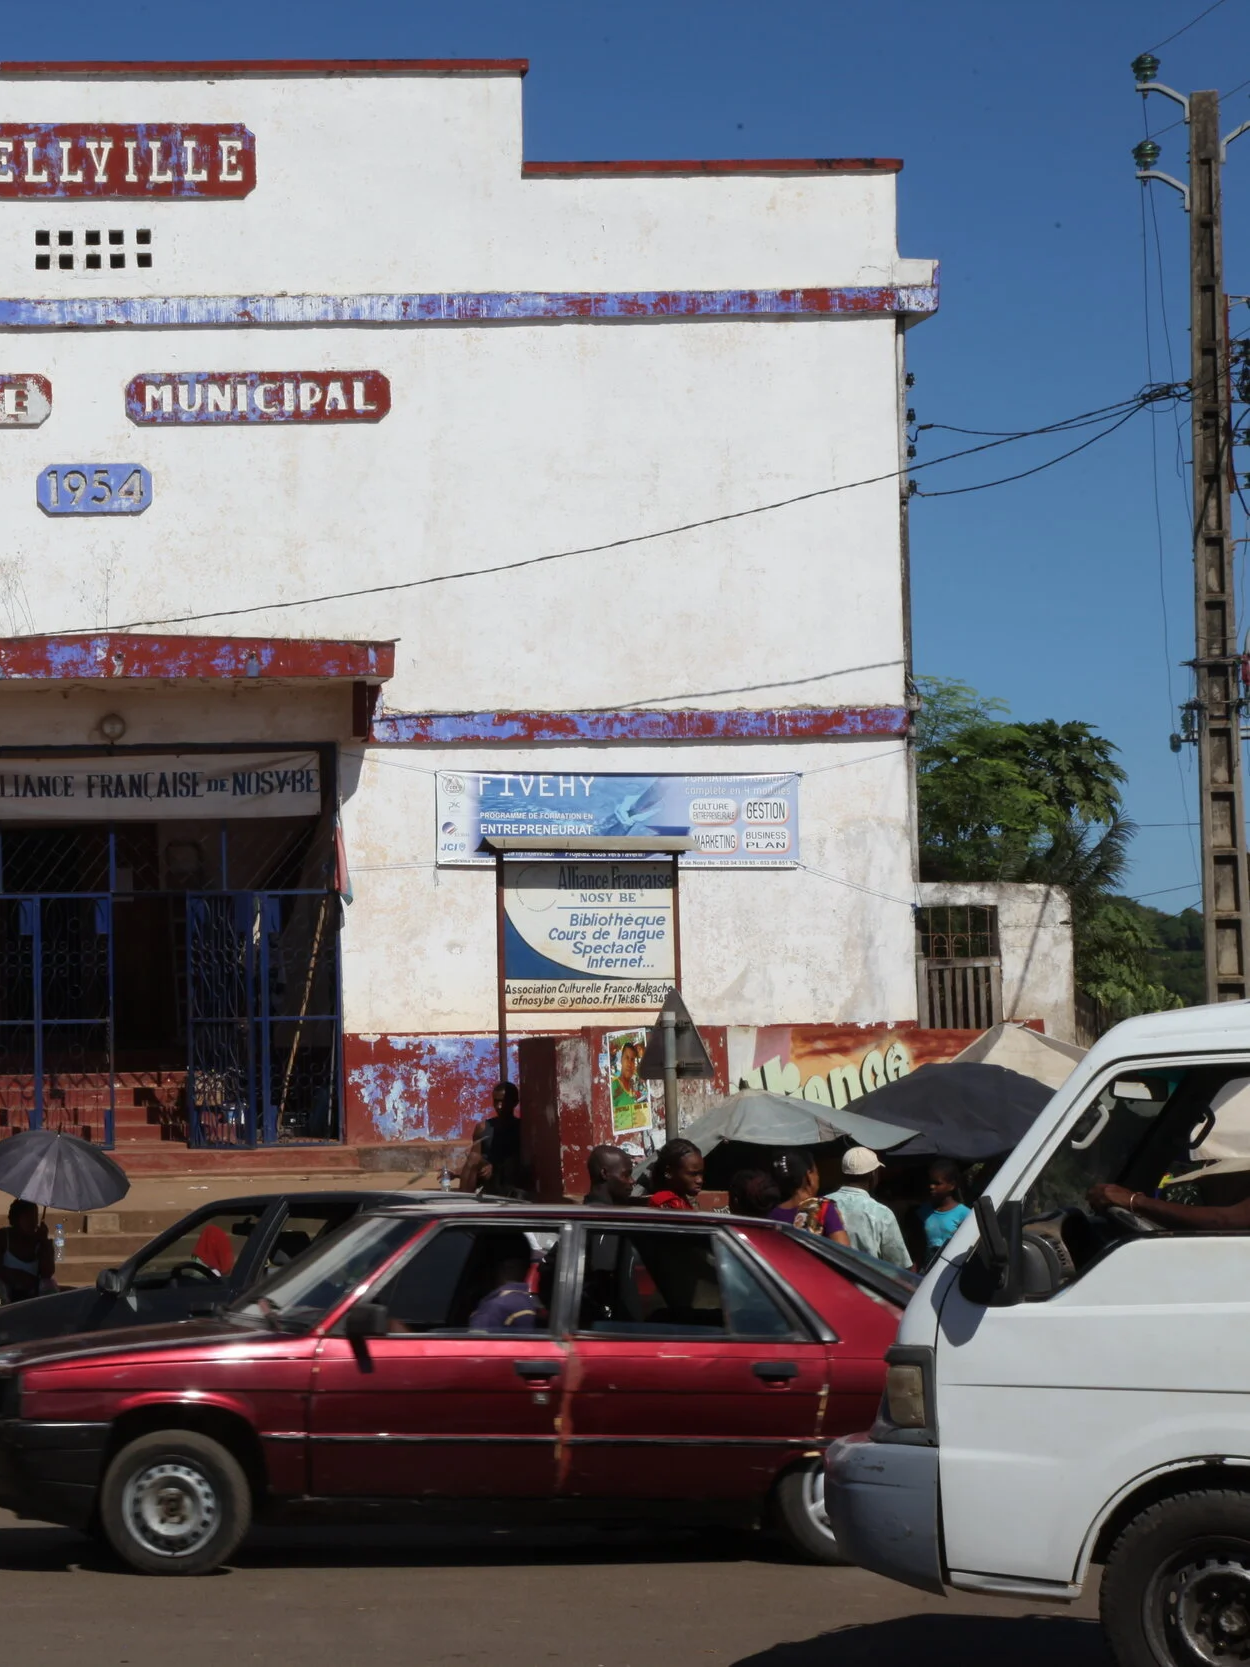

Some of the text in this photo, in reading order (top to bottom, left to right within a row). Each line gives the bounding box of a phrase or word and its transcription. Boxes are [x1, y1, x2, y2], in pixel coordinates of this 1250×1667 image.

[145, 381, 377, 413] MUNICIPAL
[47, 469, 143, 506] 1954
[86, 771, 204, 801] FRANÇAISE
[206, 778, 230, 792] DE
[479, 774, 595, 797] FIVEHY
[692, 803, 729, 811] CULTURE
[746, 802, 785, 819] GESTION
[480, 812, 527, 820] PROGRAMME
[539, 812, 582, 820] FORMATION
[480, 823, 594, 835] ENTREPRENEURIAT
[745, 832, 787, 840] BUSINESS
[441, 843, 458, 851] JCI
[694, 834, 736, 849] MARKETING
[558, 866, 673, 892] Alliance Française
[580, 893, 637, 902] NOSY BE
[569, 913, 667, 929] Bibliothèque
[548, 927, 665, 944] Cours de langue
[572, 942, 647, 958] Spectacle
[586, 955, 654, 969] Internet...
[505, 983, 557, 994] Association
[558, 983, 601, 993] Culturelle
[512, 995, 556, 1008] afnosybe
